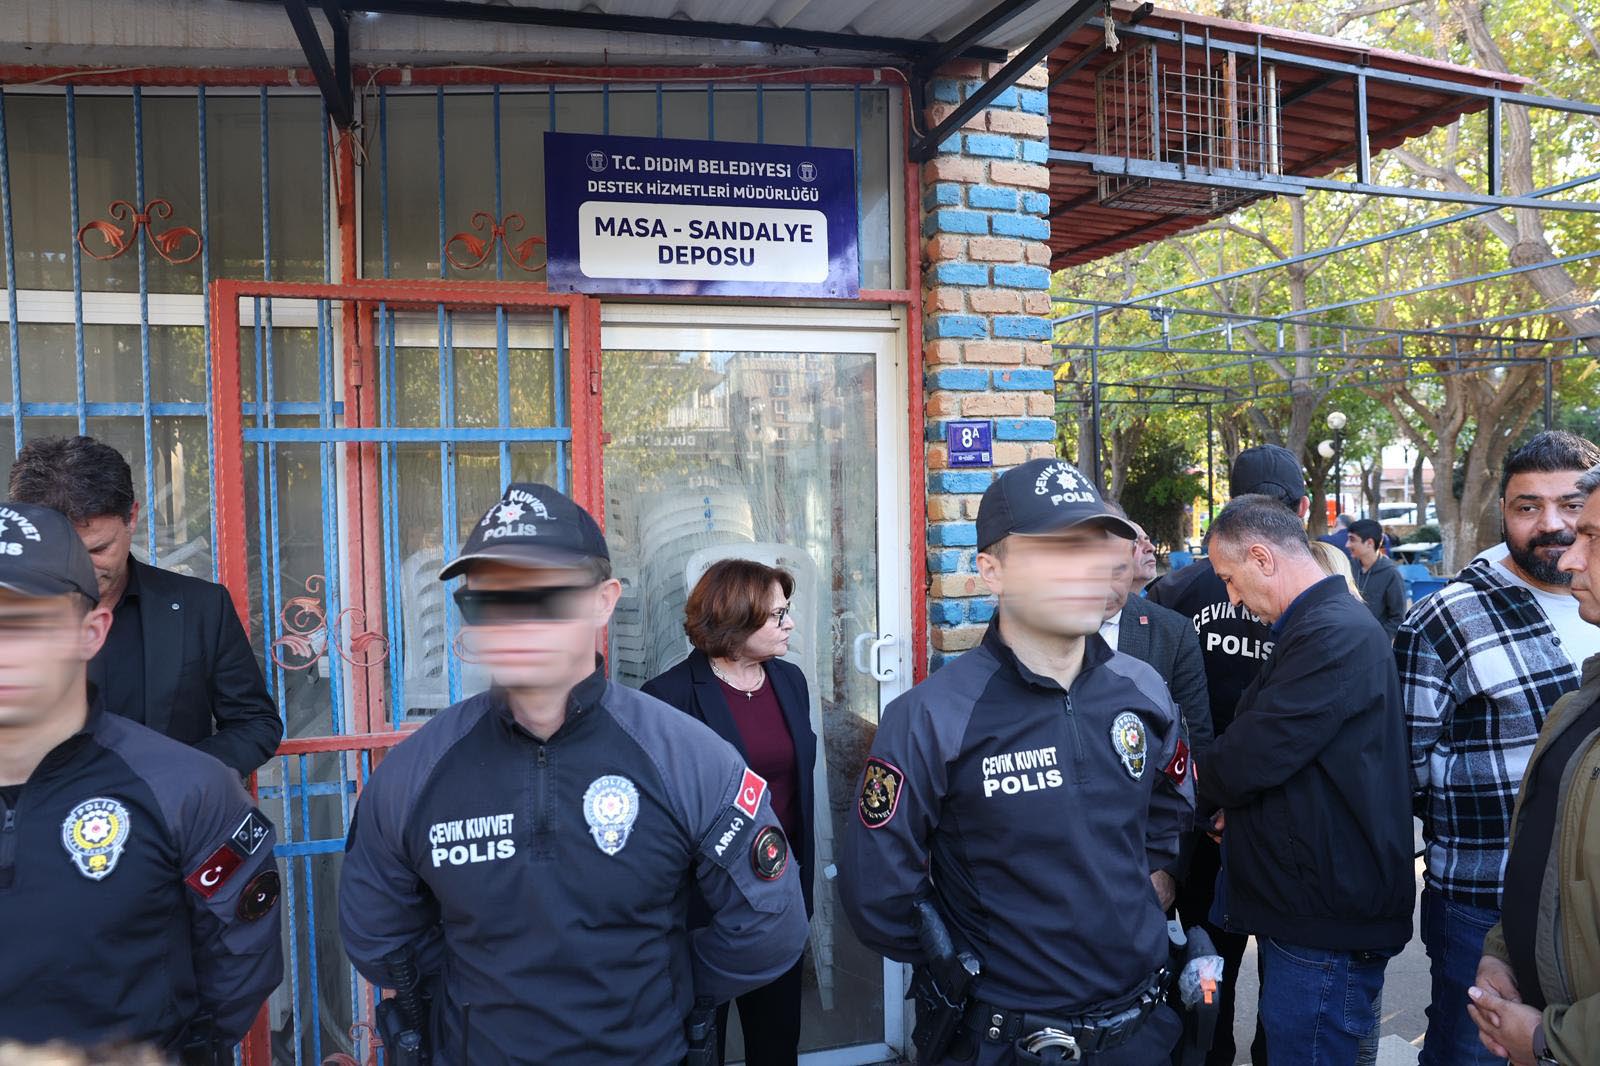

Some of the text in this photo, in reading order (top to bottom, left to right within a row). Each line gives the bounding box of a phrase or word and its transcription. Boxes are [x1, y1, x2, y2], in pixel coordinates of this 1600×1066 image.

[612, 154, 641, 171] T.C.
[587, 180, 819, 202] DESTEK HİZMETLERİ MÜDÜRLÜĞÜ
[595, 216, 668, 238] MASA
[688, 220, 814, 243] SANDALYE
[658, 245, 755, 267] DEPOSU
[1014, 746, 1057, 771] KUVVET
[466, 813, 514, 839] KUVVET
